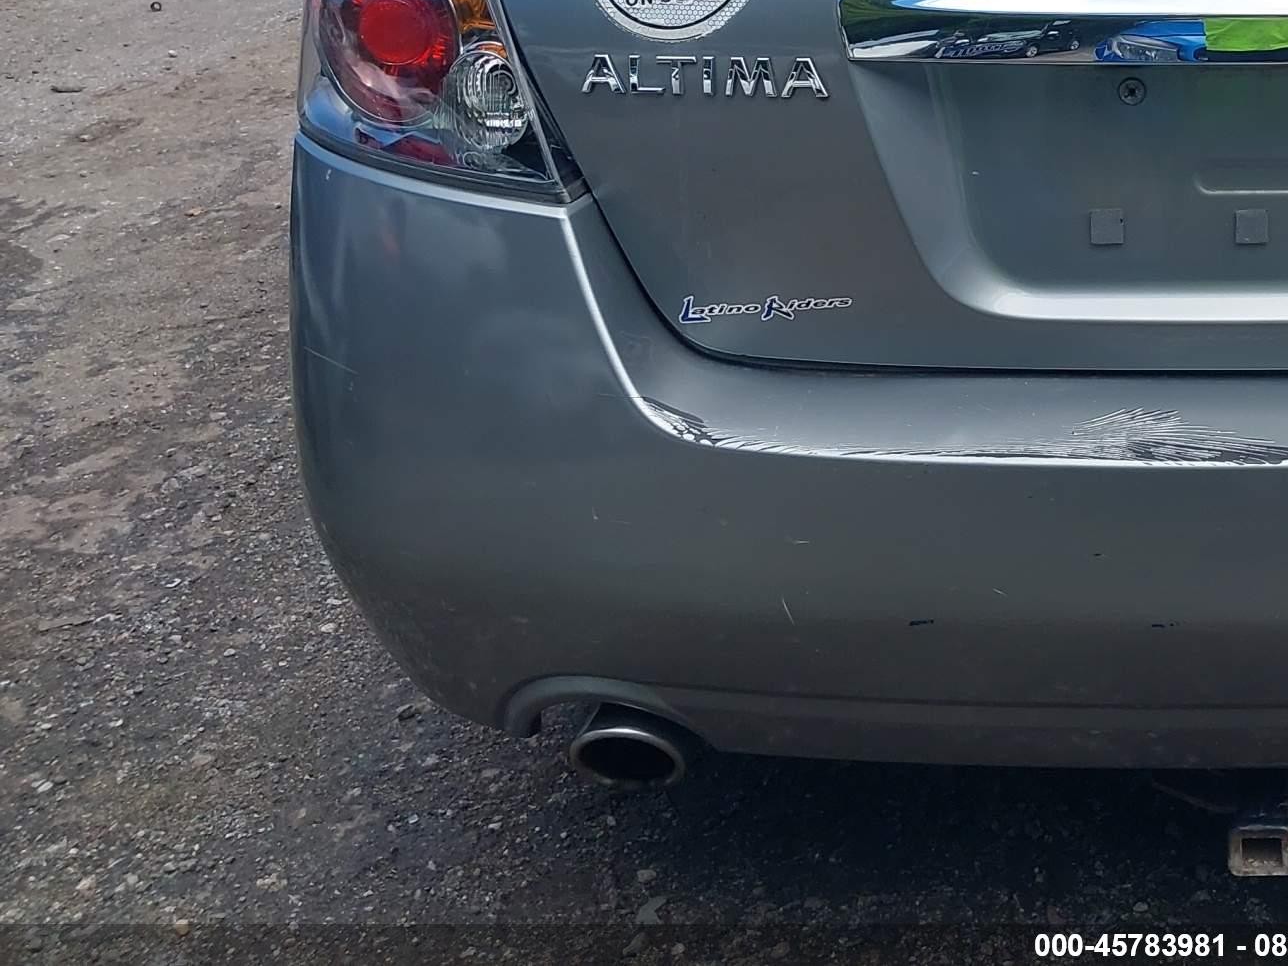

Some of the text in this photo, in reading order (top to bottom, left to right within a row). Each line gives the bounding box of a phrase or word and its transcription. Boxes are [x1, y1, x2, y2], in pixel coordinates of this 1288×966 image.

[580, 53, 831, 99] ALTIMA
[679, 295, 853, 324] Latino Riders
